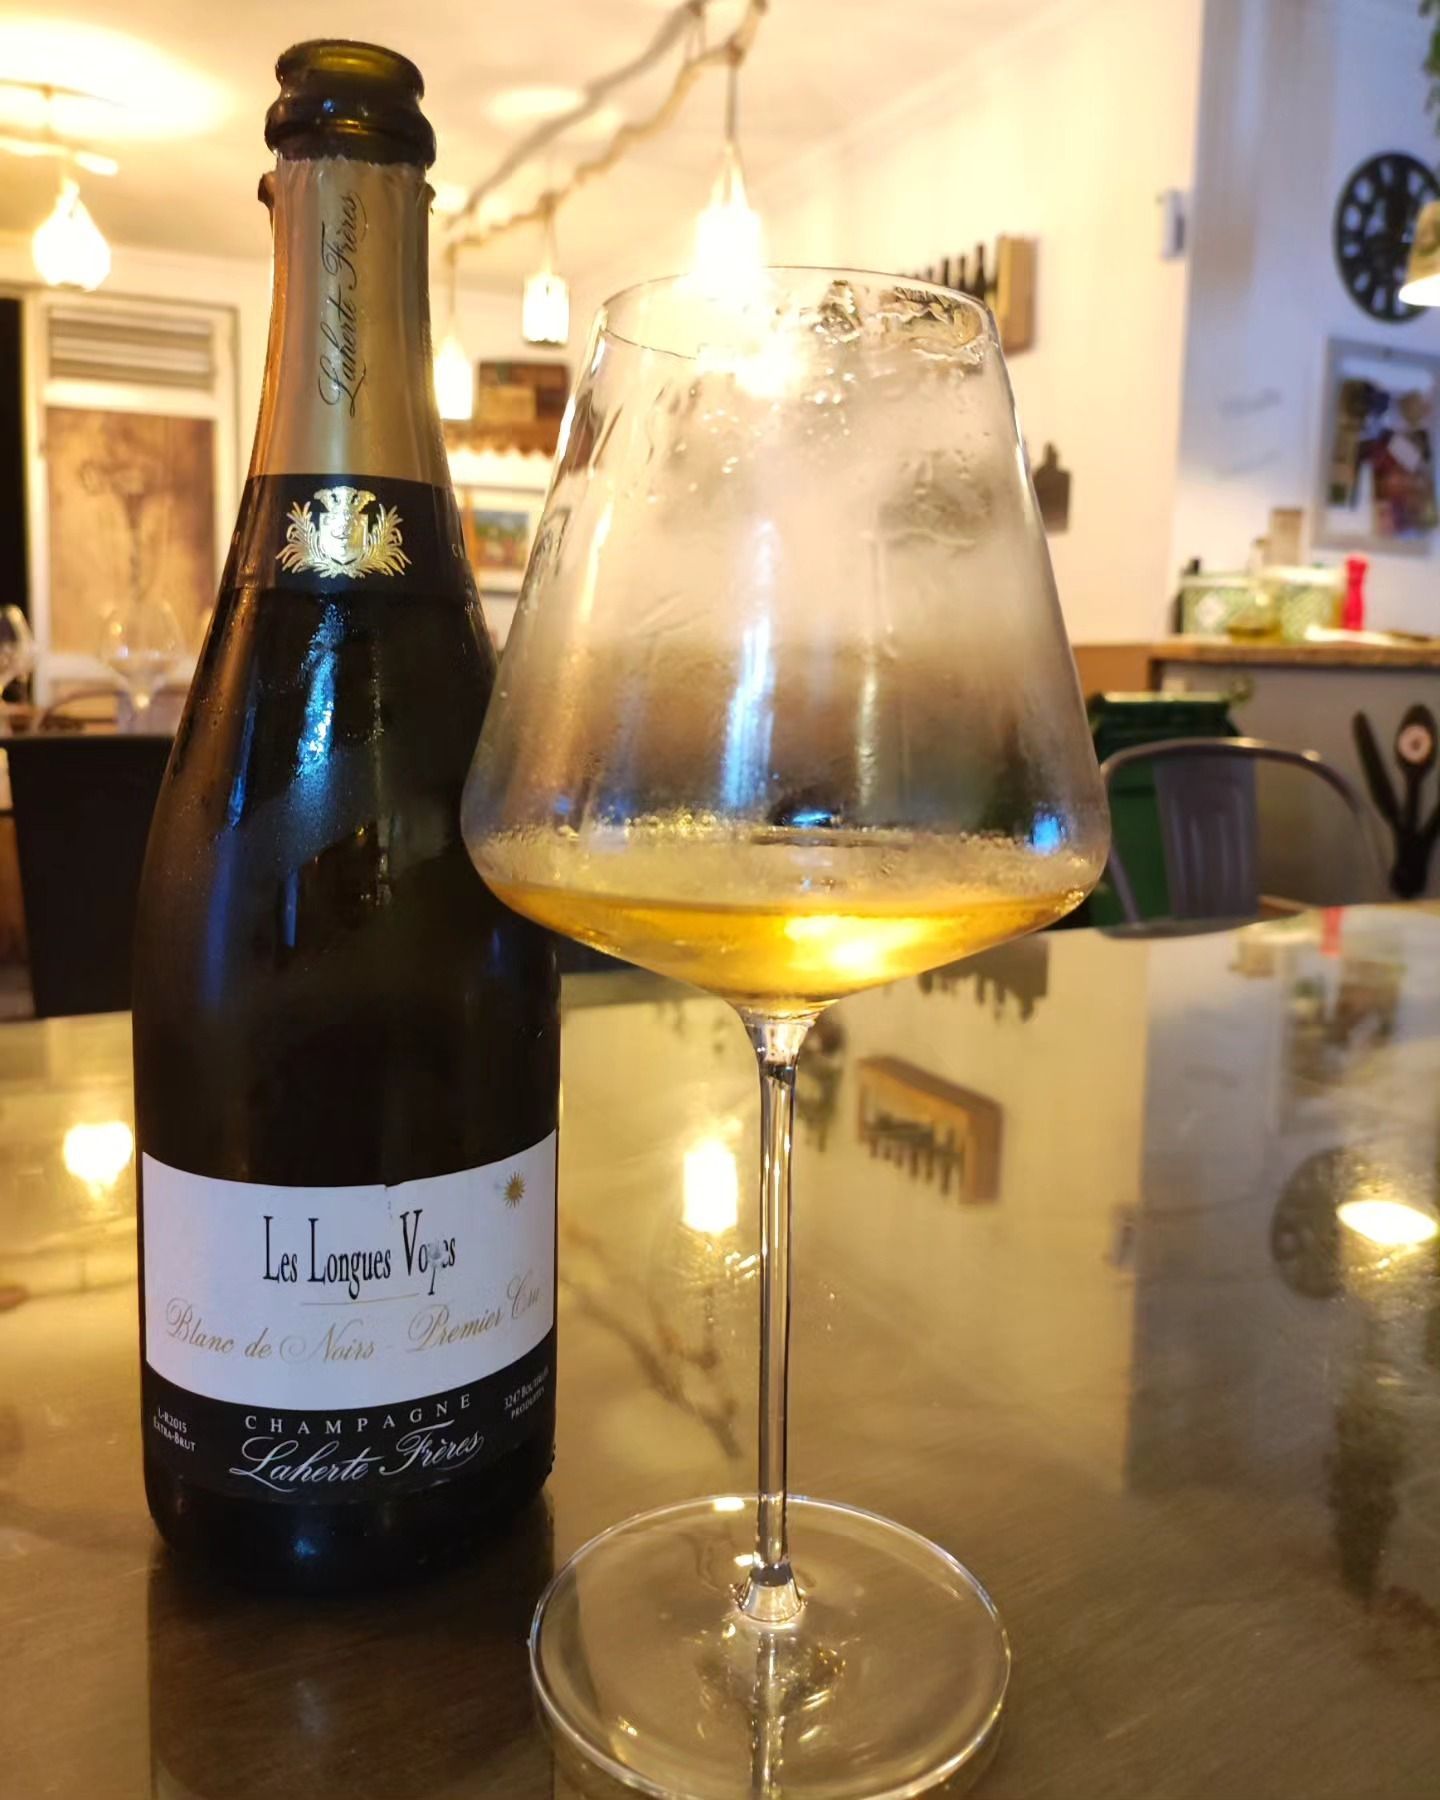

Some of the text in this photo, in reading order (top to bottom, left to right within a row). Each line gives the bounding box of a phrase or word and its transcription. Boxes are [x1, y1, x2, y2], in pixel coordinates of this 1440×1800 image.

[318, 191, 368, 417] Laherte Frères
[263, 1215, 297, 1283] Les
[307, 1217, 391, 1300] Longues
[165, 1297, 234, 1354] Blanc
[244, 1327, 273, 1359] de
[279, 1319, 375, 1364] Noirs
[406, 1303, 504, 1353] Premier
[244, 1393, 471, 1435] CHAMPAGNE
[229, 1419, 485, 1493] Laherte Frères
